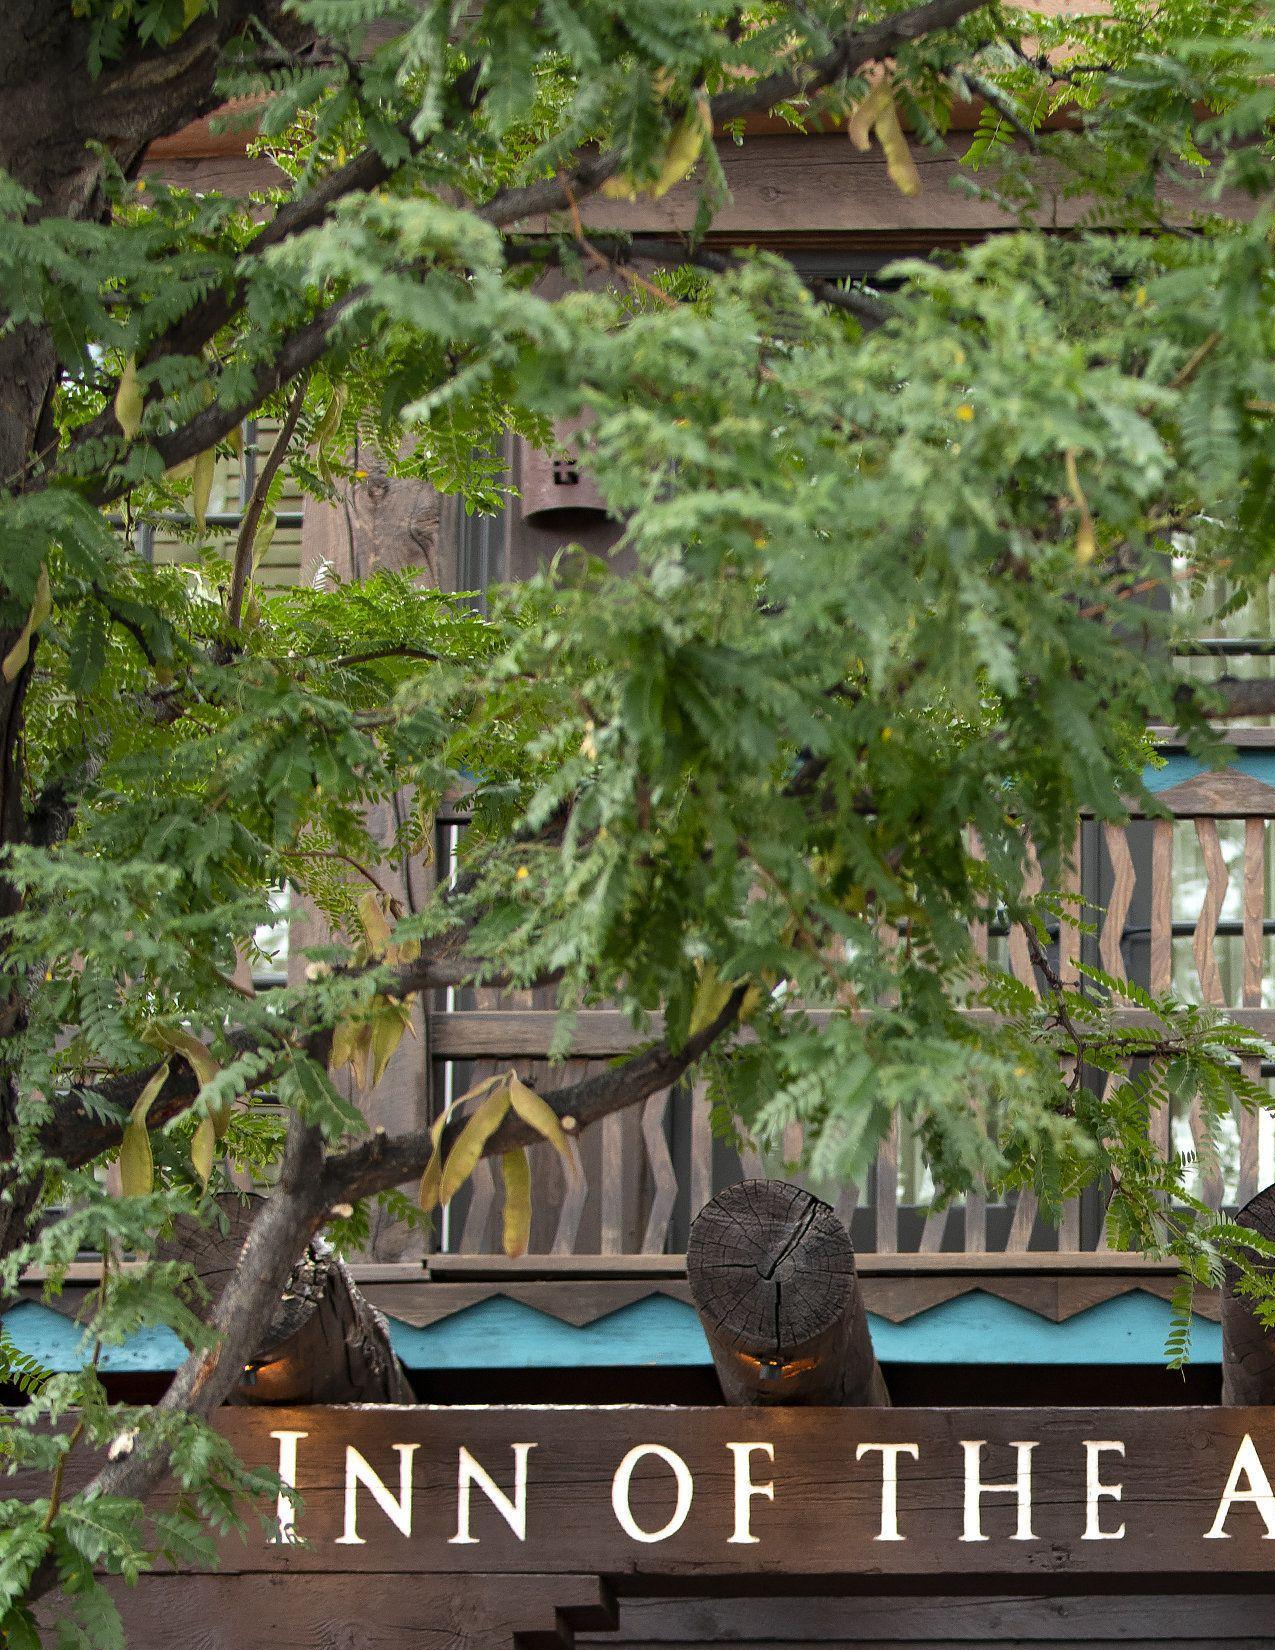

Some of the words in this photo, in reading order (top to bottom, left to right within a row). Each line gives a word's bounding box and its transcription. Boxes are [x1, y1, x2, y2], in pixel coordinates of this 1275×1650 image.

[267, 1430, 538, 1545] INN
[611, 1442, 775, 1545] OF
[855, 1440, 1126, 1543] THE
